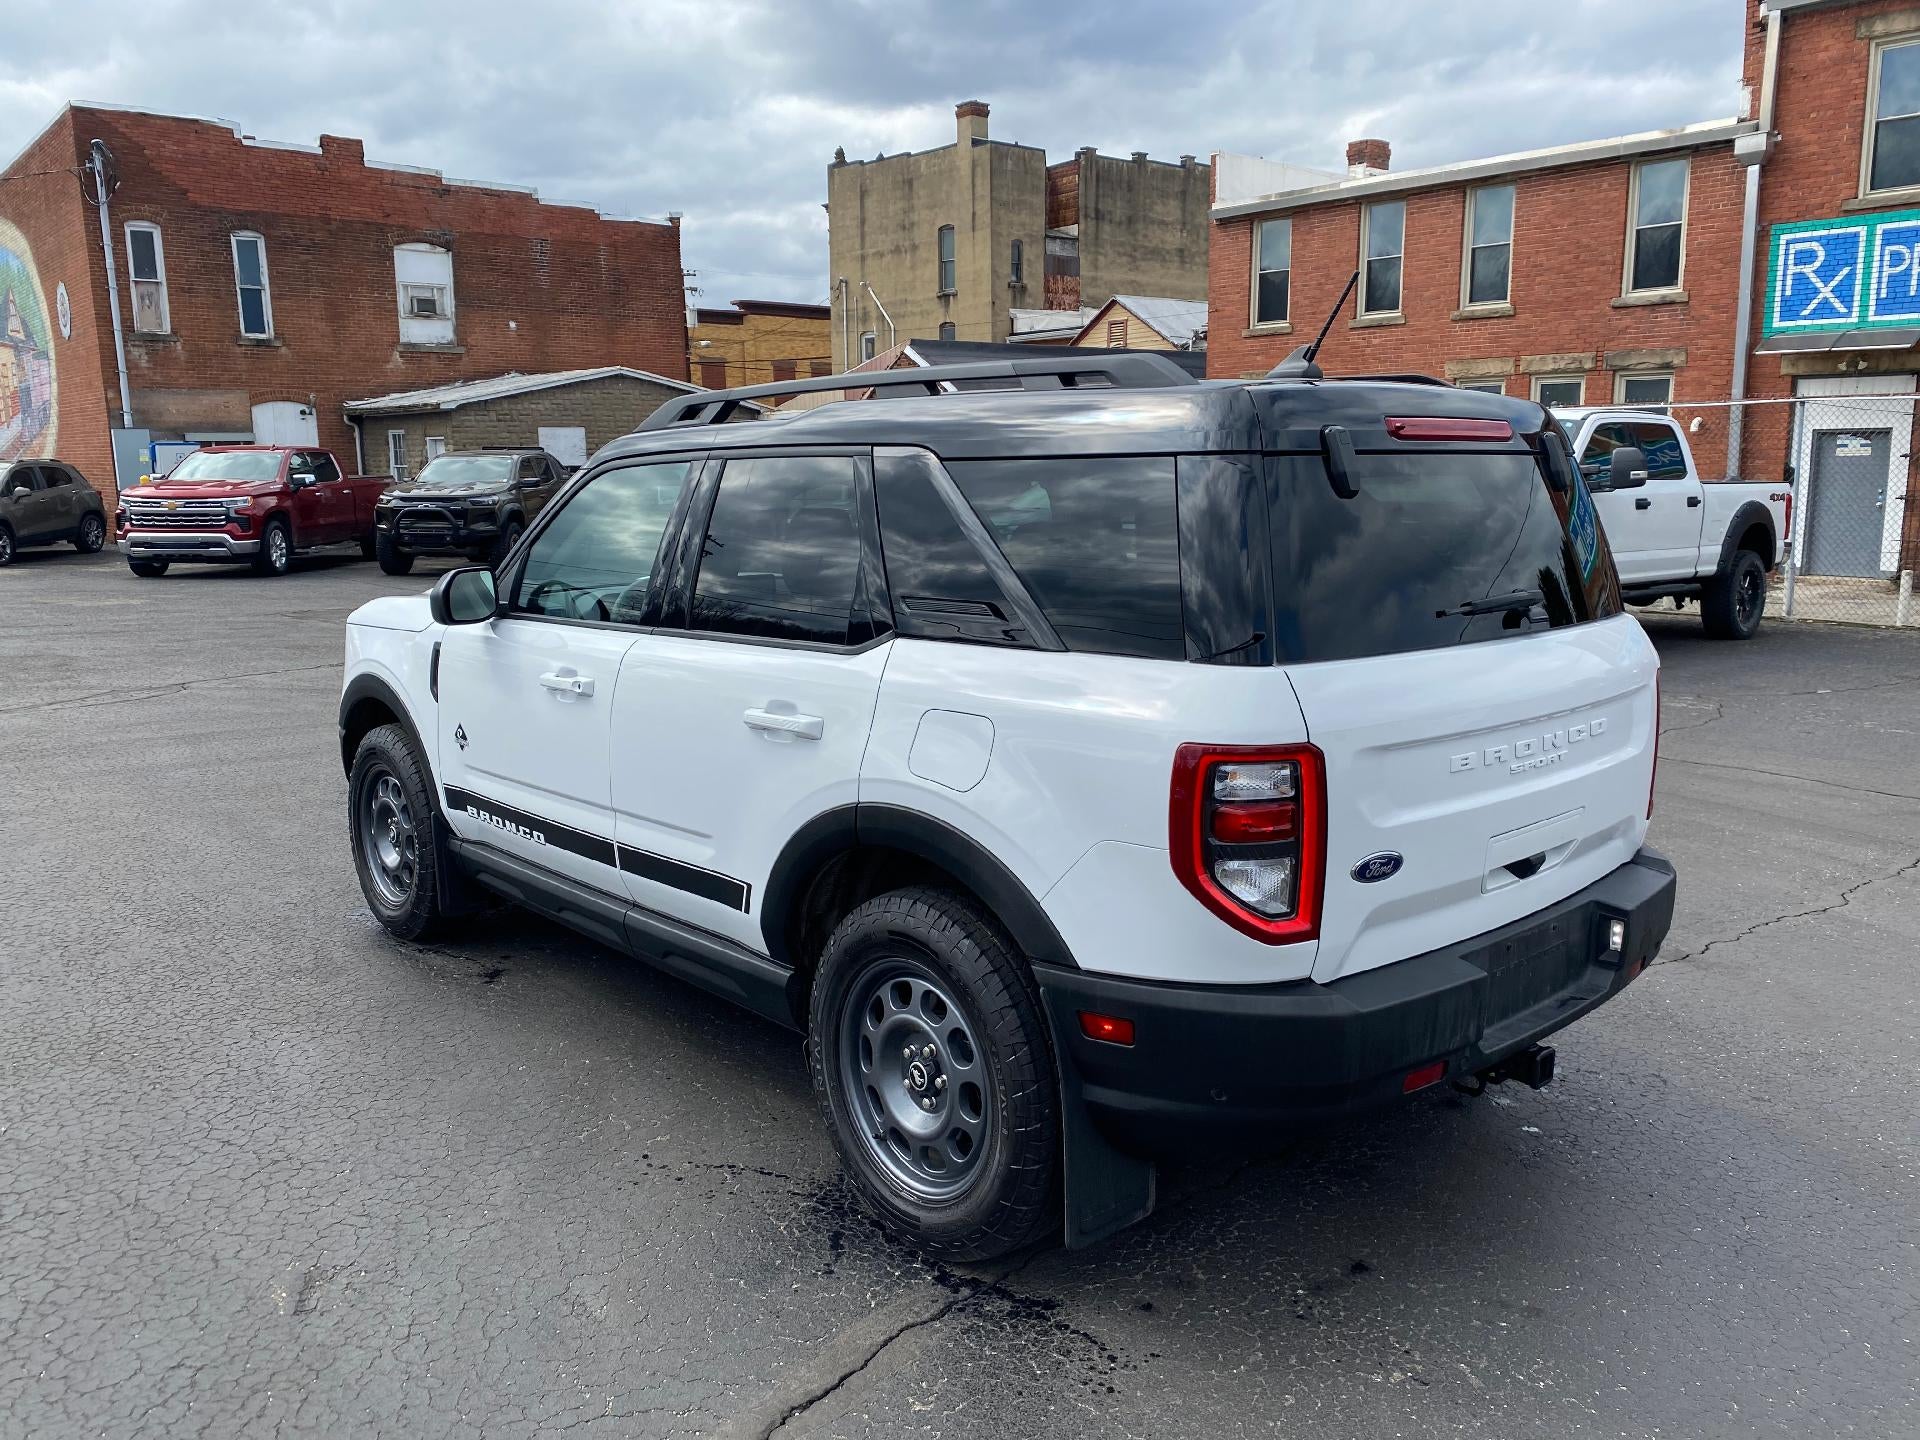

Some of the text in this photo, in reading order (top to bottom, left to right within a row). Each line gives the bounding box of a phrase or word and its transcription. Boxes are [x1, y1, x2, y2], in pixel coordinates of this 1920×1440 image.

[1450, 718, 1607, 774] BRONCO
[1510, 750, 1568, 775] SPORT
[467, 804, 547, 846] BRONCO
